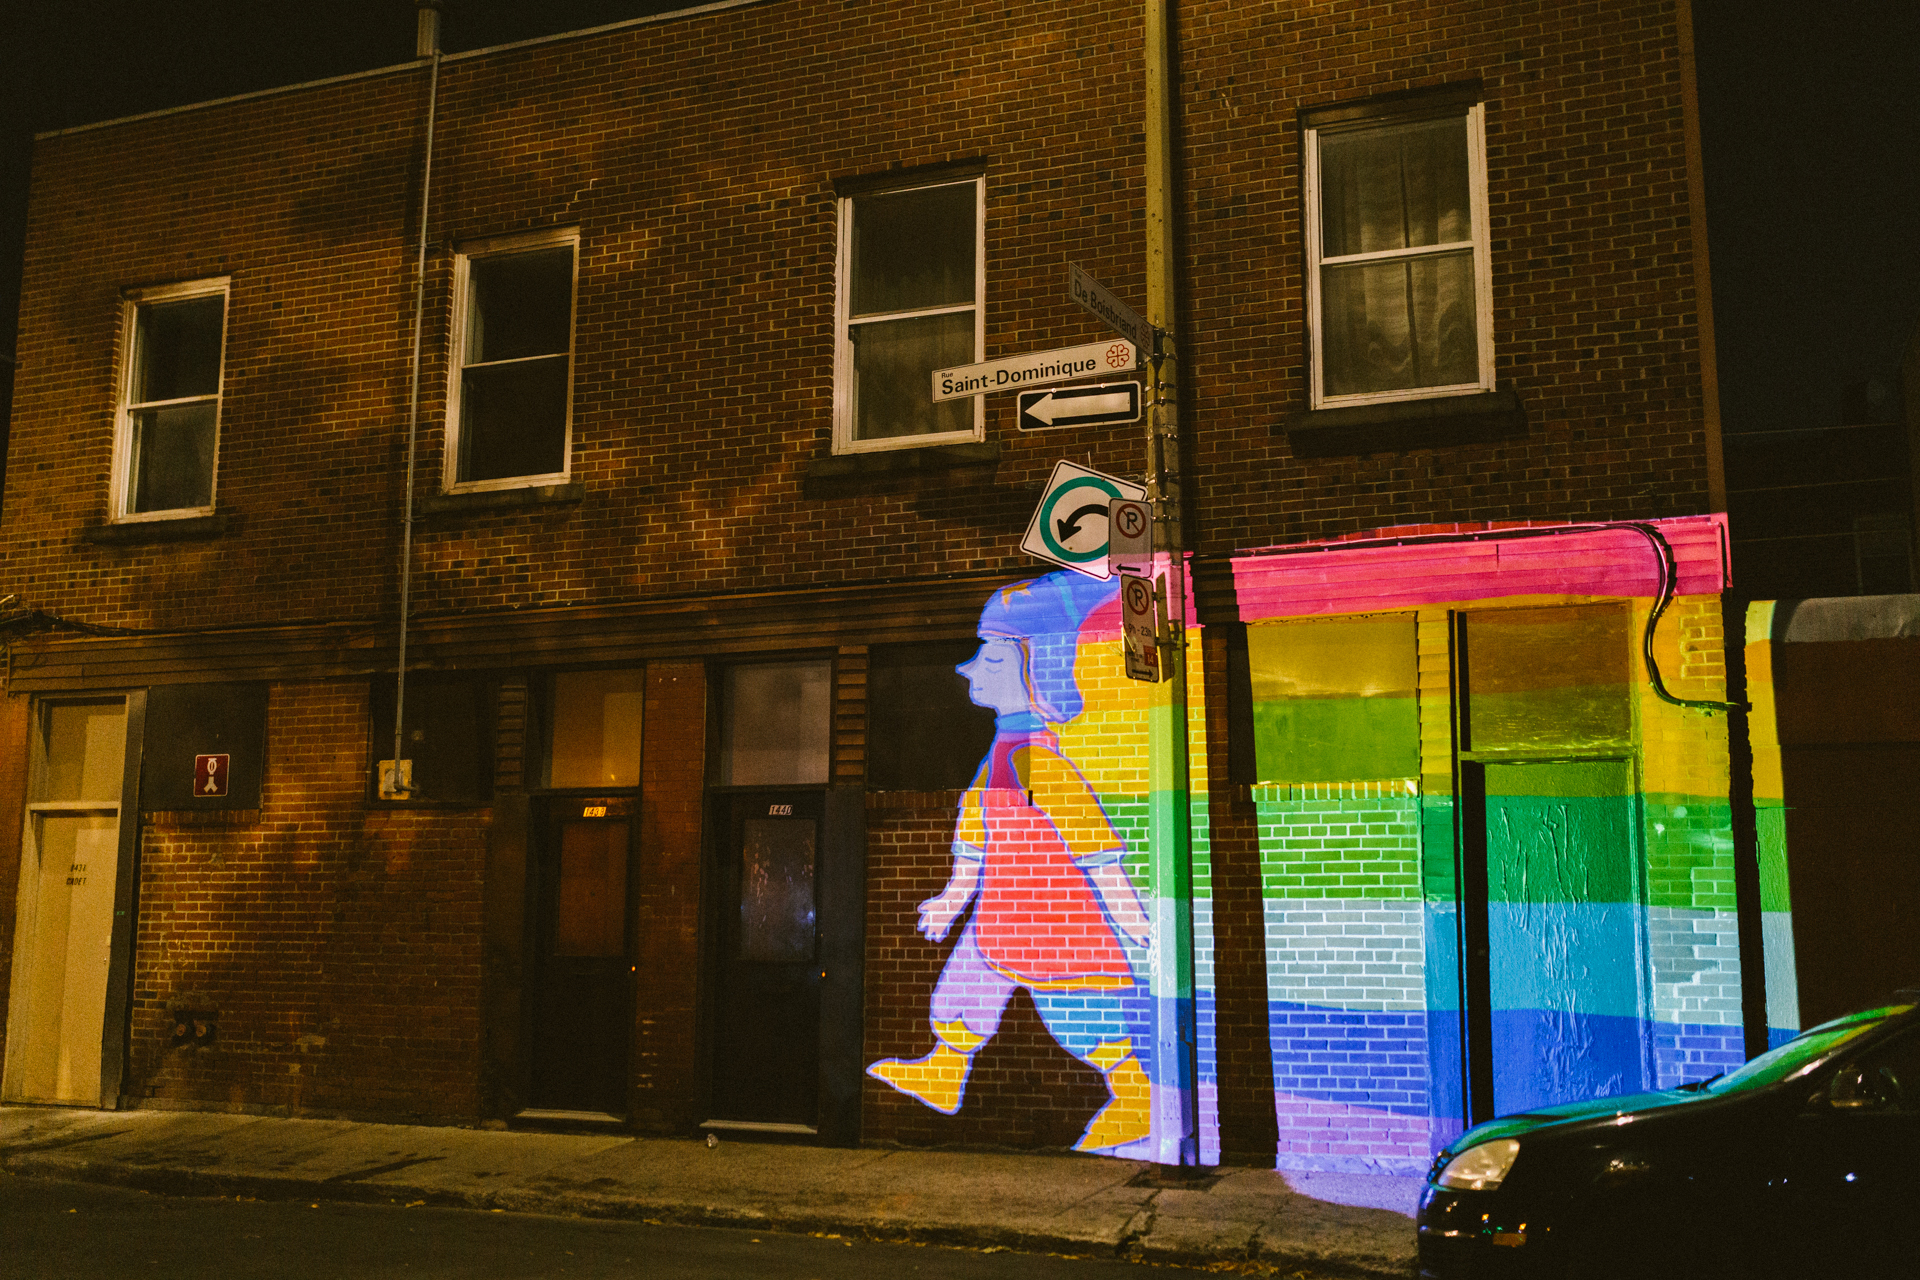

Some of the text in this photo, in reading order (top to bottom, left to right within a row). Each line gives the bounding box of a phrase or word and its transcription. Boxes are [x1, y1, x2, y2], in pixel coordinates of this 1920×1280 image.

[1075, 281, 1137, 339] De Boisbriand
[941, 358, 1097, 395] Saint-Dominique
[770, 805, 793, 815] 1440
